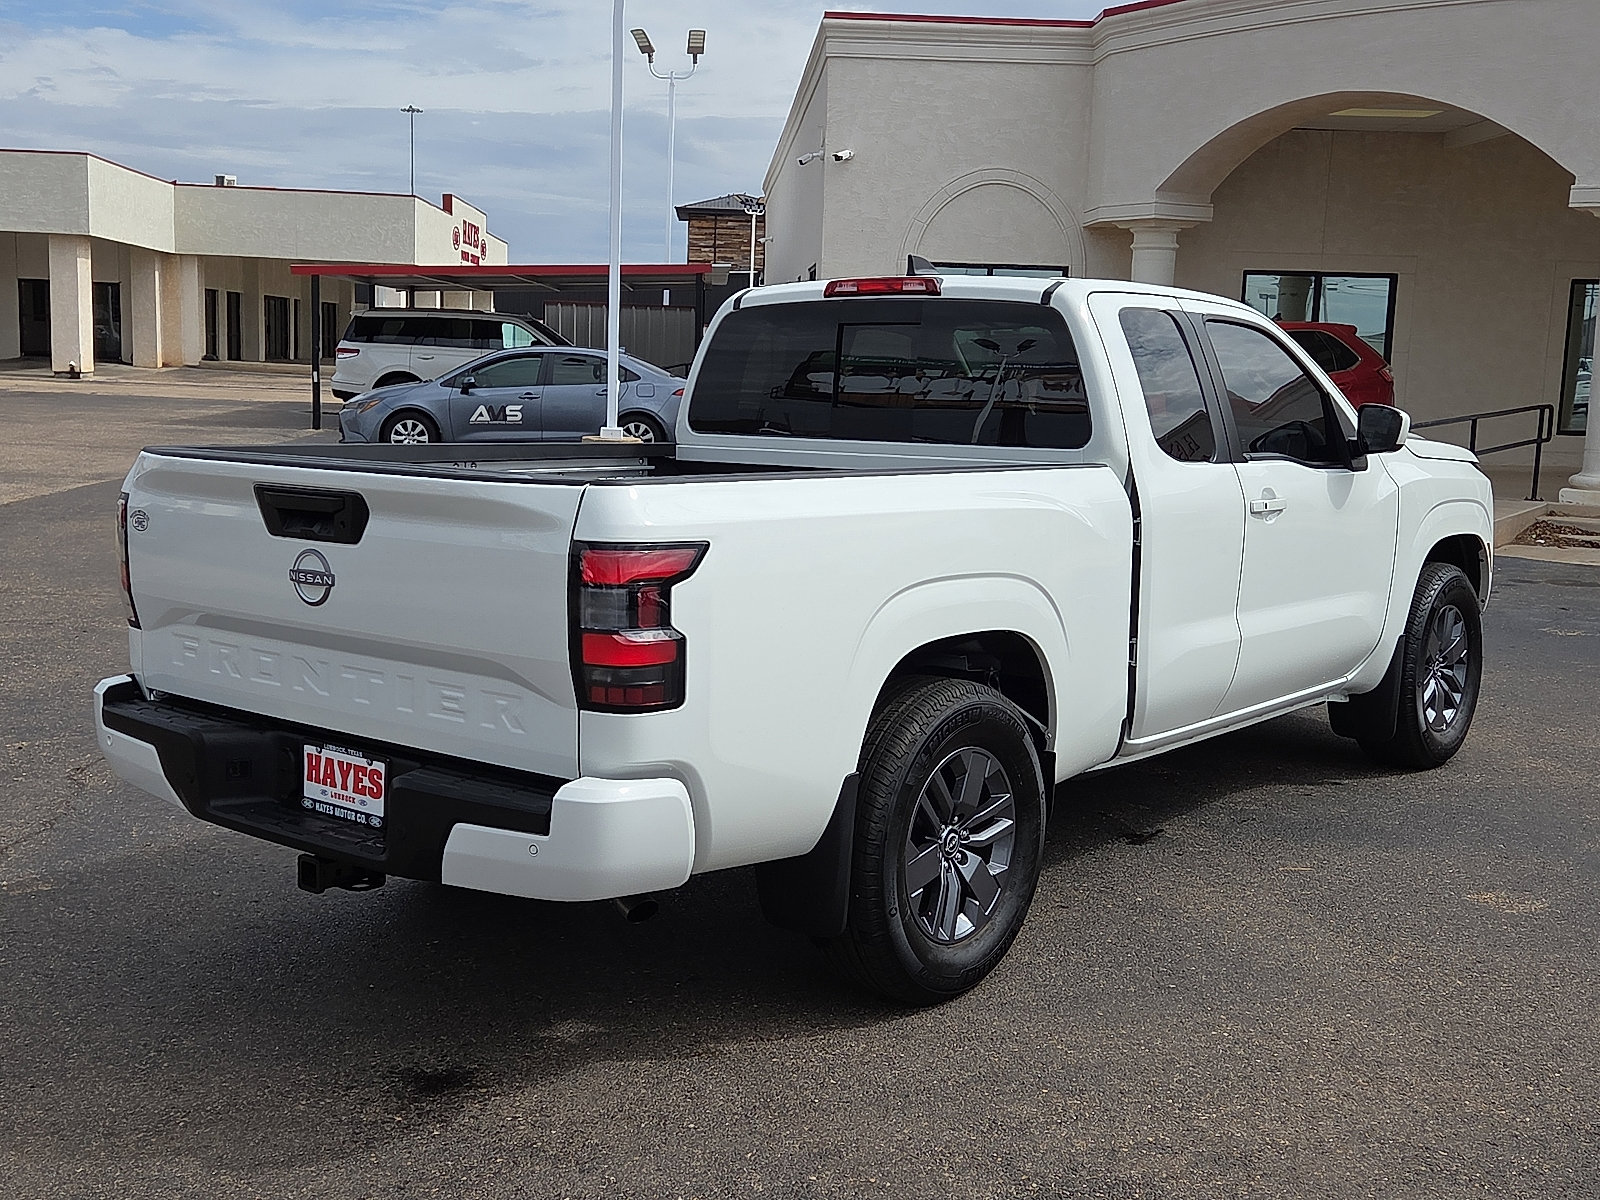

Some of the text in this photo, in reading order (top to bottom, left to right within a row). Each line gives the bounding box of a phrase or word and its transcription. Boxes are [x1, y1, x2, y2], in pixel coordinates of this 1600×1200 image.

[469, 404, 524, 422] AMS
[290, 570, 332, 585] NISSAN
[171, 631, 527, 735] FRONTIER
[306, 752, 383, 800] HAYES
[315, 802, 334, 815] HAYES
[334, 807, 355, 821] MOTOR
